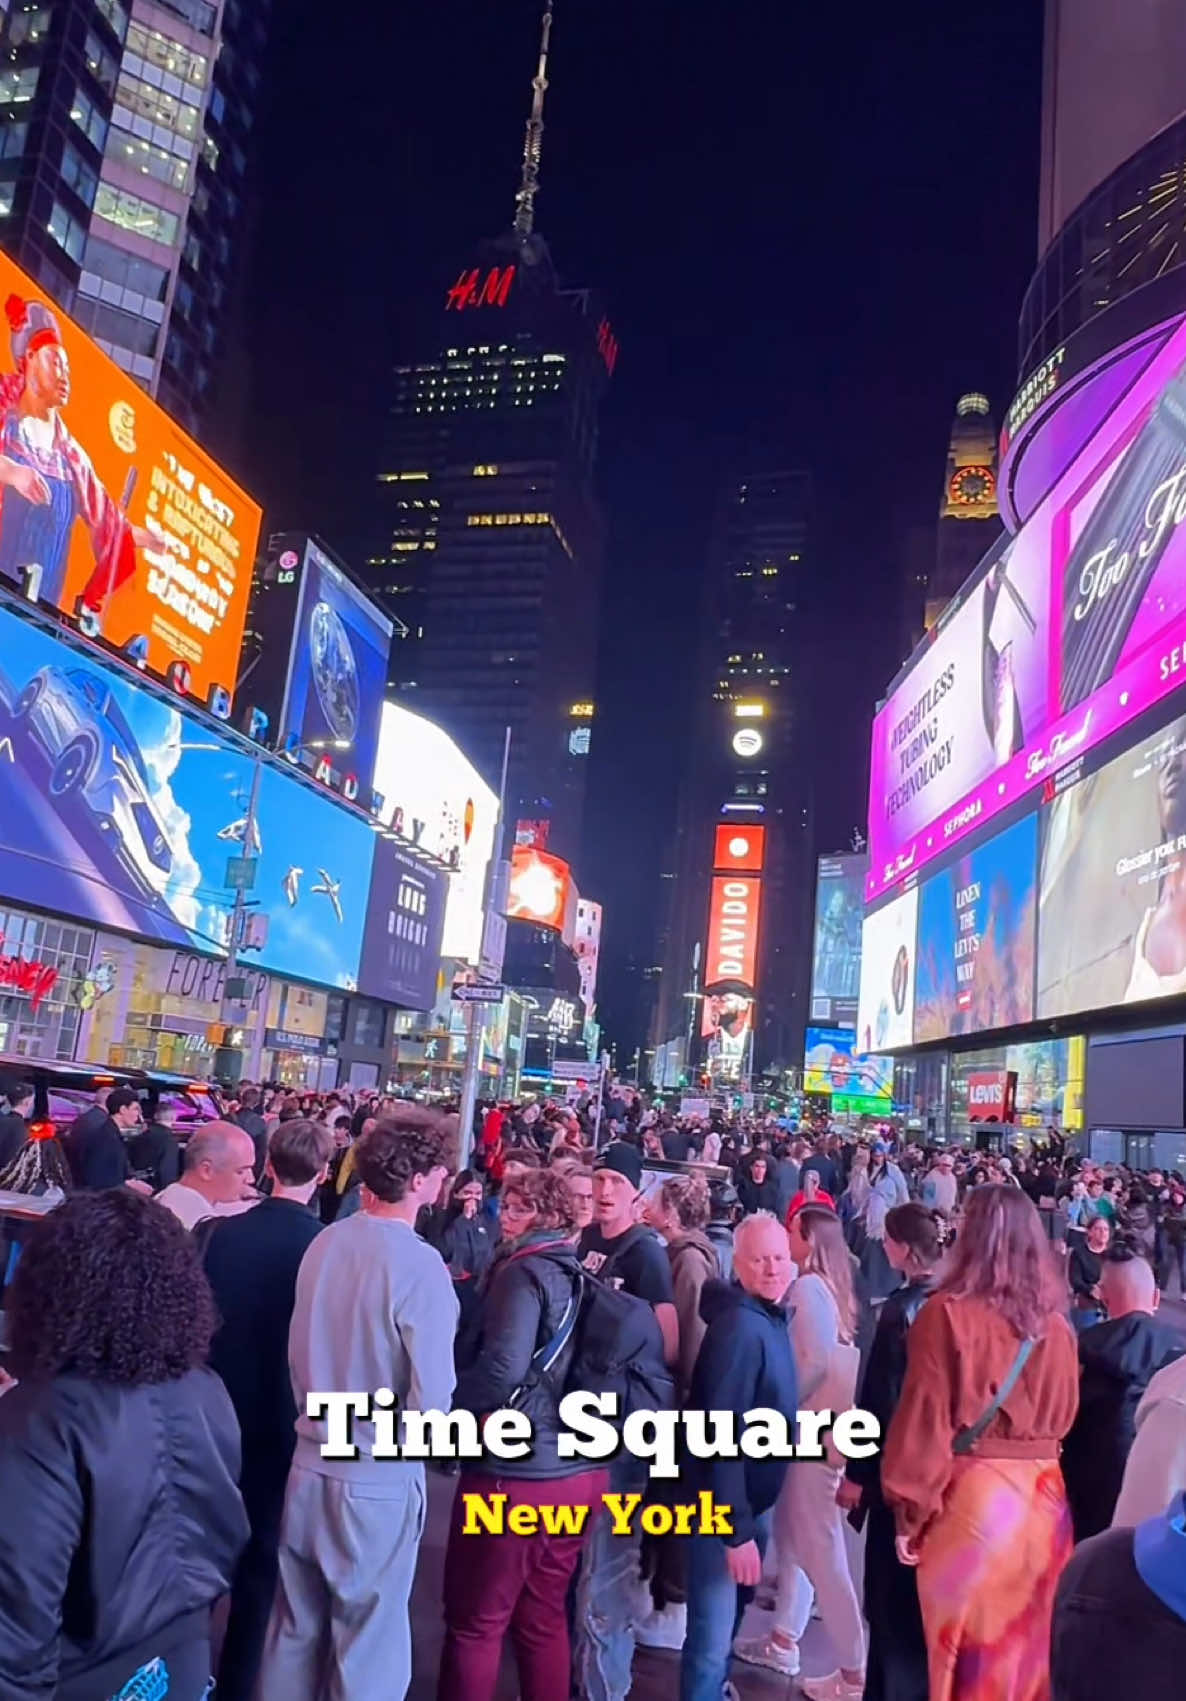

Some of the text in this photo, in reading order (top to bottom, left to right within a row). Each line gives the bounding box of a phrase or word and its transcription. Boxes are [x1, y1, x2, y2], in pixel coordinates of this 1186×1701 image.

[446, 265, 516, 311] H&M
[1010, 347, 1065, 422] MARRIOTT
[277, 571, 295, 584] LG
[1074, 538, 1130, 621] Too
[891, 663, 955, 751] WEIGHTLESS
[886, 735, 954, 822] TECHNOLOGY
[899, 717, 938, 775] TUBING
[943, 798, 983, 838] SEPHORA
[717, 882, 749, 975] DAVIDO
[166, 951, 267, 1012] FOREER
